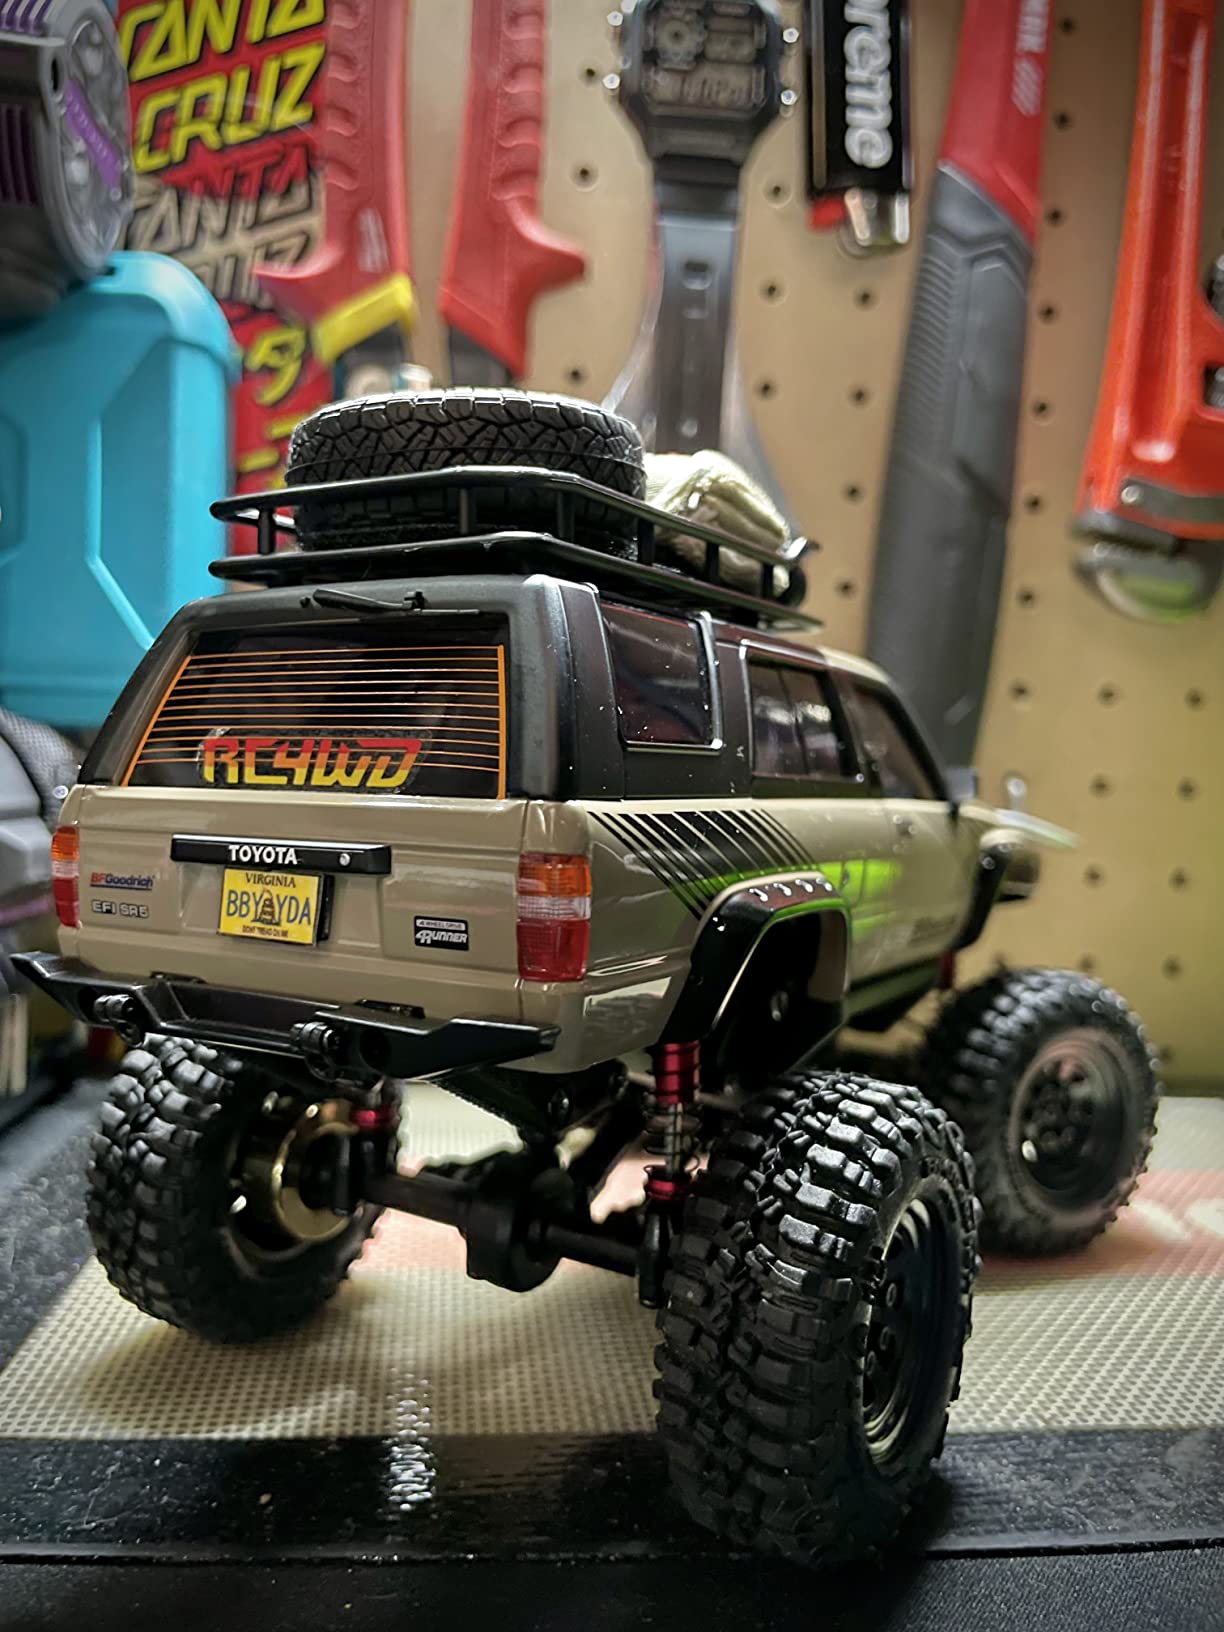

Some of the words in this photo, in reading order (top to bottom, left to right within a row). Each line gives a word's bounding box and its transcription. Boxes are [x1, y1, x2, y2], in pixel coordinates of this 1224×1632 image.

[133, 42, 326, 175] CRUZ
[203, 738, 422, 787] RC4WD
[228, 845, 298, 865] TOYOTA
[246, 872, 297, 889] VIRGINIA
[92, 900, 116, 915] EFI
